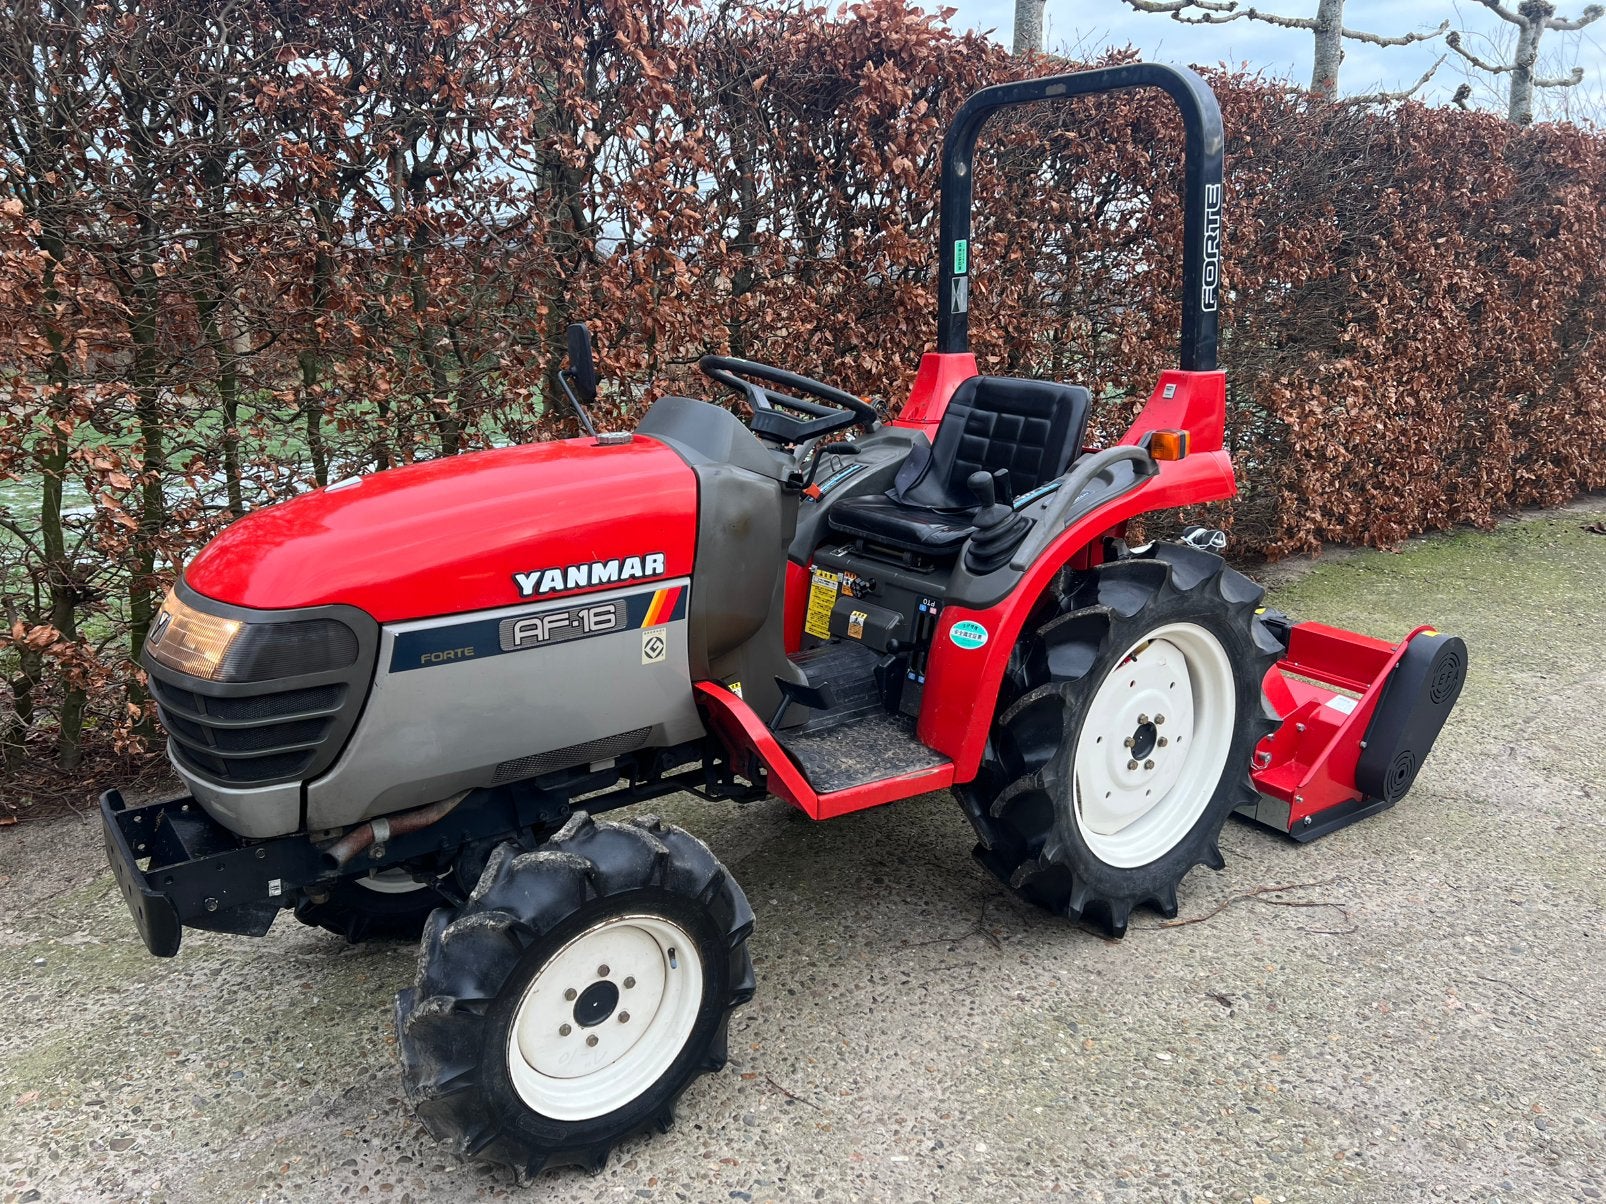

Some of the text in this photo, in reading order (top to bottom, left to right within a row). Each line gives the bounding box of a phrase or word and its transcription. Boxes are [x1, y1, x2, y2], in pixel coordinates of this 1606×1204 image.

[1202, 183, 1221, 313] FORTE
[514, 552, 665, 596] YANMAR
[923, 598, 936, 608] PTO
[420, 646, 475, 665] FORTE
